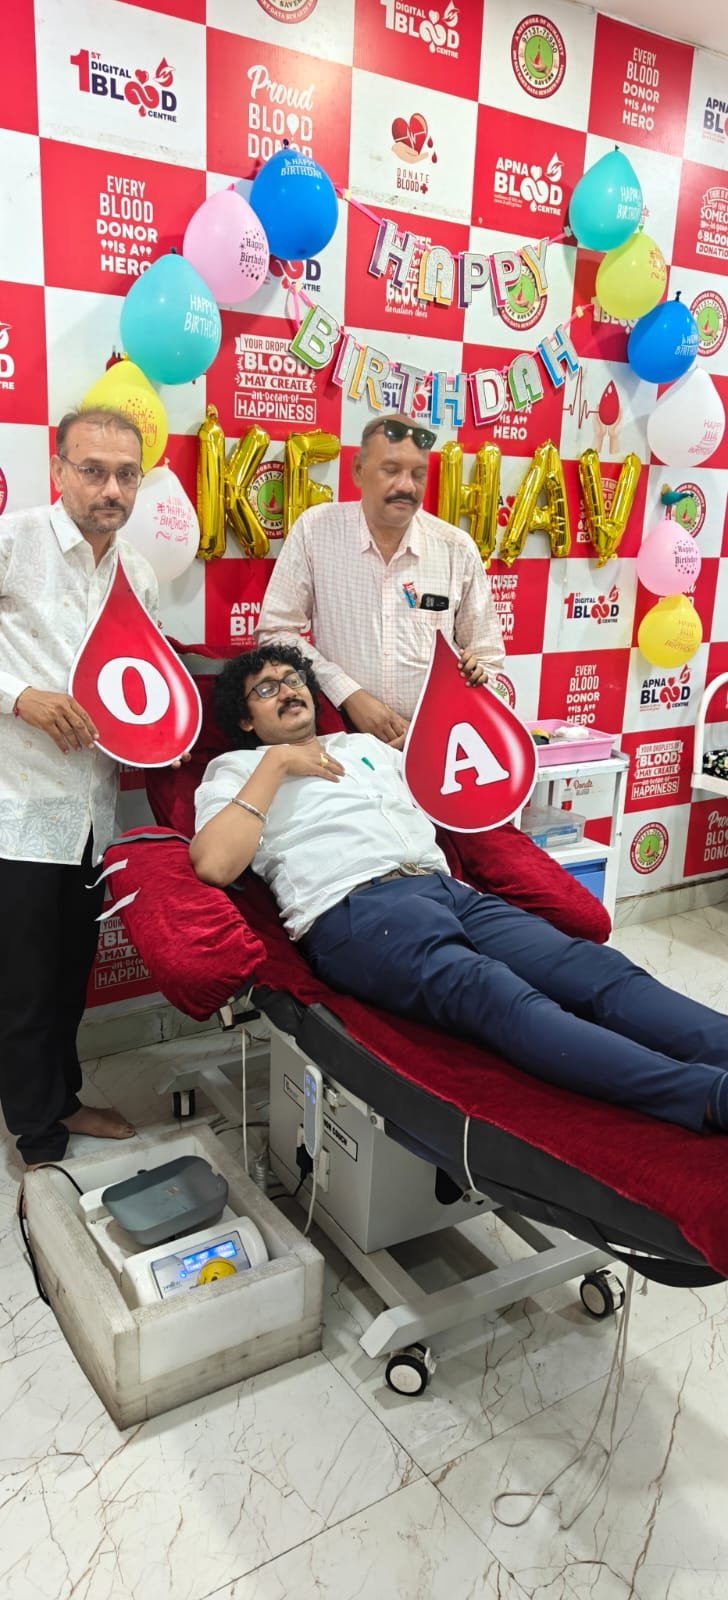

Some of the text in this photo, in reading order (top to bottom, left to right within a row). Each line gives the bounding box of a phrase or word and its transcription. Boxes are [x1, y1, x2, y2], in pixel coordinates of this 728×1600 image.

[396, 2, 426, 19] DIGITAL
[436, 47, 459, 59] CENTRE
[633, 48, 656, 67] EVERY
[91, 60, 132, 79] DIGITAL
[627, 60, 660, 88] BLOOD
[247, 65, 316, 111] Proud
[622, 81, 660, 104] DONOR
[147, 110, 177, 122] CENTRE
[622, 110, 654, 131] HERO
[496, 156, 529, 177] APNA
[396, 168, 430, 184] DONATE
[107, 174, 146, 199] EVERY
[396, 178, 420, 192] BLOOD
[100, 192, 154, 224] BLOOD
[538, 204, 561, 216] CENTRE
[96, 218, 158, 244] DONOR
[704, 231, 728, 248] BLOO
[698, 244, 728, 259] DONATIO
[368, 217, 549, 310] HAPPY
[244, 338, 263, 350] YOUR
[244, 352, 309, 376] BLOOD
[245, 374, 308, 392] MAY CREATE
[238, 399, 314, 421] HAPPINESS
[494, 426, 527, 440] HERO
[231, 602, 261, 615] APN
[576, 664, 596, 676] EVERY
[96, 656, 170, 725] O
[570, 676, 600, 692] BLOOD
[642, 678, 666, 689] APNA
[566, 692, 600, 704] DONOR
[566, 714, 596, 725] HERO
[440, 720, 510, 796] A
[640, 752, 678, 766] BLOOD
[640, 766, 676, 777] MAY CREATE
[634, 781, 678, 798] HAPPINESS
[704, 846, 728, 862] DONO
[105, 950, 128, 961] MAY
[98, 966, 150, 986] HAPPIN
